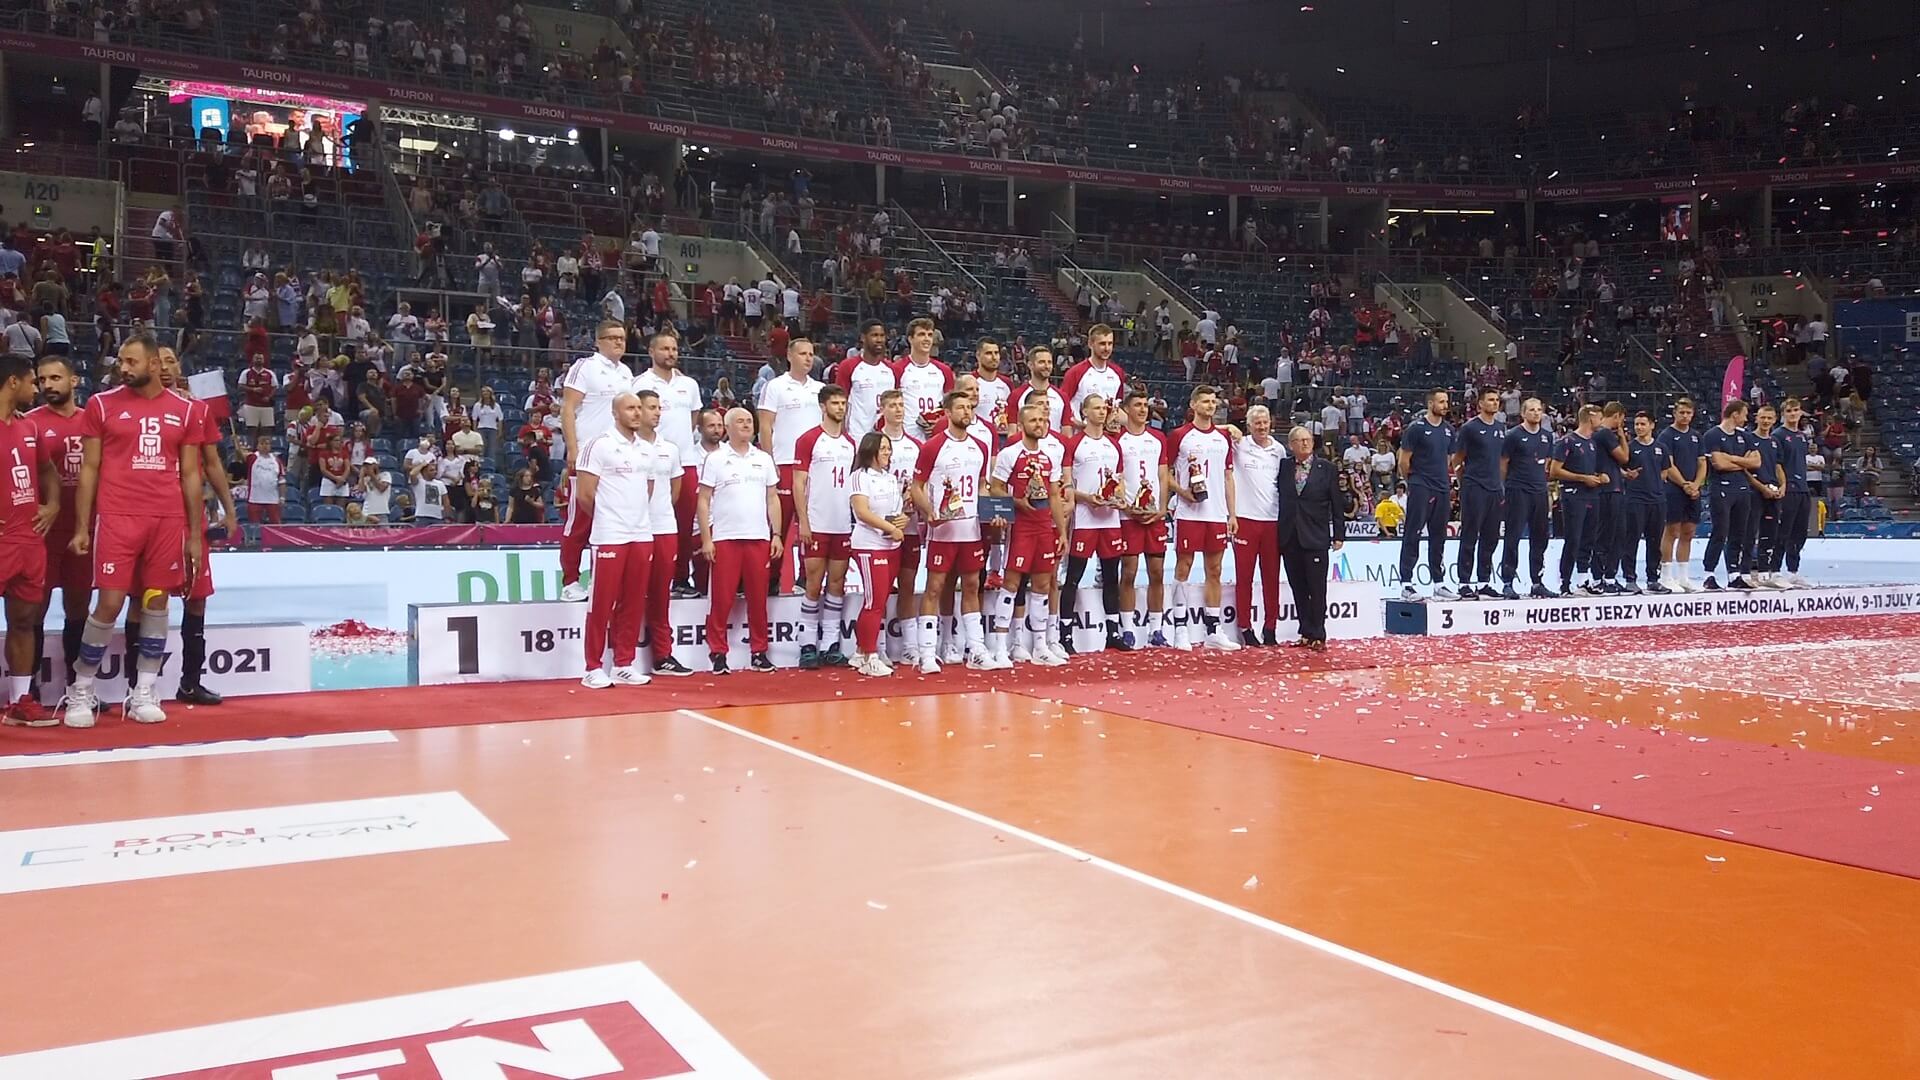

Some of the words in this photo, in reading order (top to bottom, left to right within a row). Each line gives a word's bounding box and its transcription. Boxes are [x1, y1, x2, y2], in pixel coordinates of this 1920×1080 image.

[81, 46, 136, 62] TAURON
[241, 67, 291, 82] TAURON
[388, 88, 433, 101] TAURON
[522, 105, 565, 119] TAURON
[648, 121, 687, 135] TAURON
[761, 138, 798, 149] TAURON
[867, 151, 901, 162] TAURON
[969, 161, 1002, 171] TAURON
[1067, 170, 1098, 180] TAURON
[1770, 173, 1808, 182] TAURON
[1159, 178, 1190, 188] TAURON
[1250, 184, 1281, 193] TAURON
[1654, 181, 1692, 190] TAURON
[24, 182, 59, 201] A20
[1347, 187, 1378, 195] TAURON
[1444, 188, 1476, 197] TAURON
[1543, 187, 1579, 197] TAURON
[680, 243, 701, 258] A01
[918, 398, 934, 414] 99
[139, 417, 160, 434] 15
[64, 436, 83, 453] 13
[11, 448, 21, 465] 1
[831, 465, 845, 489] 14
[959, 475, 974, 499] 13
[102, 563, 115, 574] 15
[1325, 602, 1358, 620] 021
[1526, 606, 1590, 625] HUBERT
[1595, 603, 1643, 622] JERZY
[1648, 600, 1712, 619] WAGNER
[1716, 597, 1794, 616] MEMORIAL,
[1797, 593, 1859, 612] KRAKÓW,
[1863, 594, 1884, 610] 9-11
[1885, 592, 1913, 608] JULY
[1441, 609, 1454, 629] 3
[447, 616, 479, 675] 1
[103, 820, 421, 859] TURYSTYCZNY
[114, 827, 257, 849] BON
